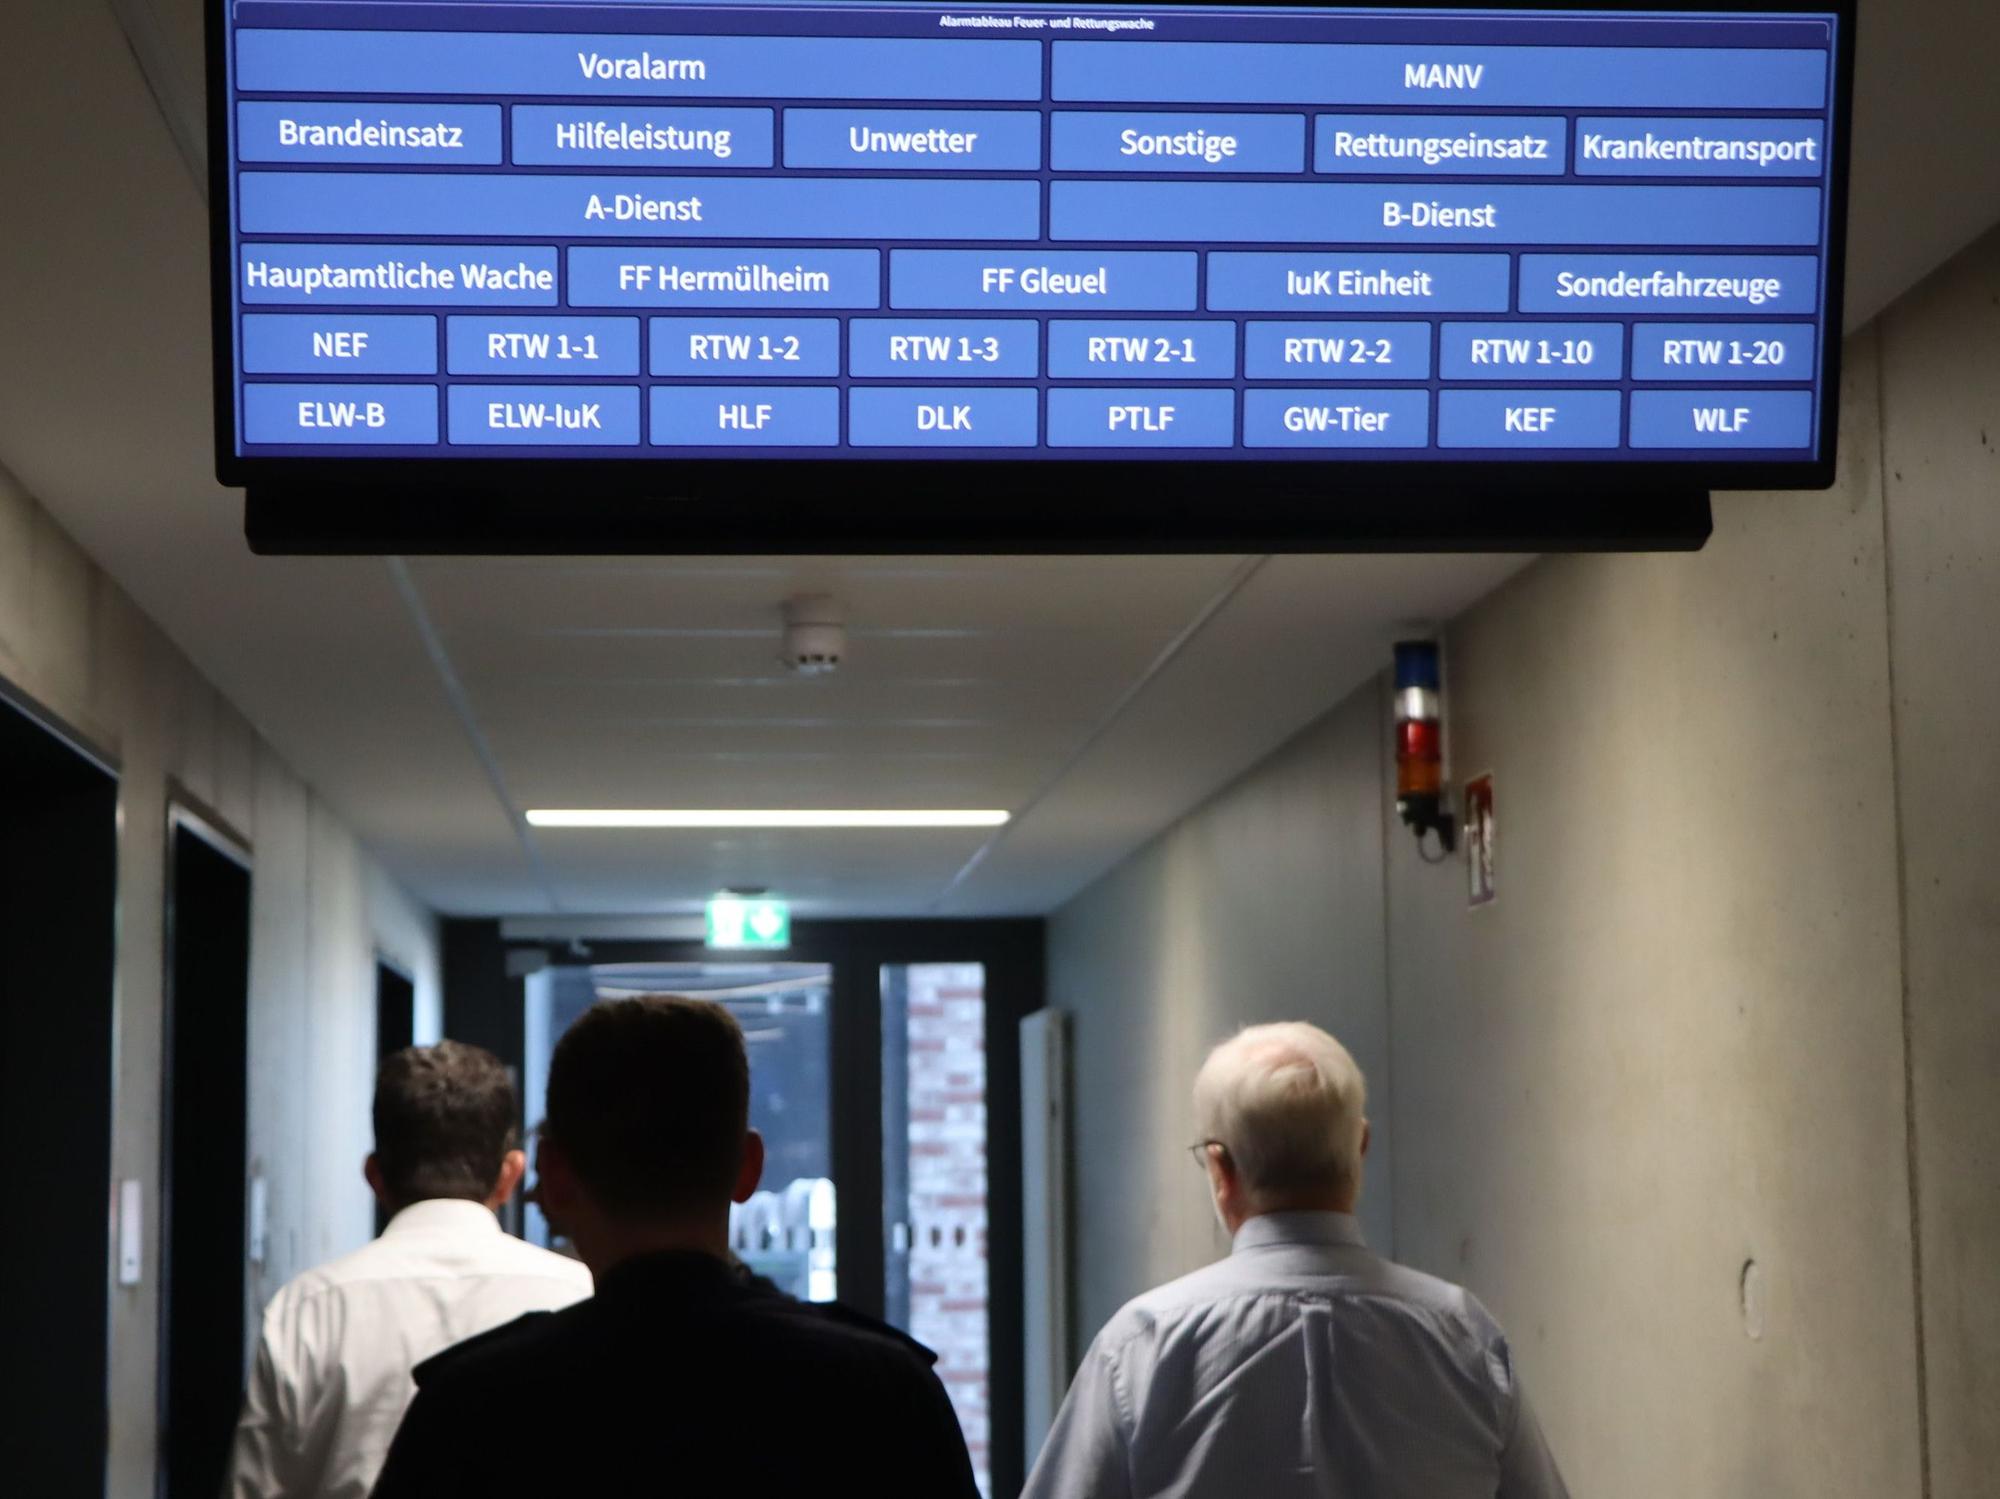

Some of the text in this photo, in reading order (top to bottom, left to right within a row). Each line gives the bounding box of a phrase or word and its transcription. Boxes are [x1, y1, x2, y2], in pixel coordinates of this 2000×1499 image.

[939, 15, 1155, 32] Alarmtableau Feuer- und Rettungswache
[577, 51, 706, 80] Voralarm
[1404, 63, 1484, 89] MANV
[279, 118, 464, 148] Brandeinsatz
[556, 121, 732, 159] Hilfeleistung
[849, 126, 978, 154] Unwetter
[1120, 128, 1238, 164] Sonstige
[1334, 131, 1548, 166] Rettungseinsatz
[1583, 132, 1816, 167] Krankentransport
[584, 193, 703, 222] A-Dienst
[1383, 201, 1496, 228] B-Dienst
[247, 261, 554, 295] Hauptamtliche Wache
[619, 264, 830, 293] FF Hermülheim
[982, 266, 1107, 295] FF Gleuel
[1287, 269, 1433, 297] IuK Einheit
[1556, 270, 1781, 305] Sonderfahrzeuge
[313, 331, 369, 358] NEF
[488, 333, 599, 360] RTW 1-1
[689, 334, 801, 361] RTW 1-2
[890, 335, 1000, 362] RTW 1-3
[1088, 336, 1197, 363] RTW 2-1
[1284, 337, 1392, 364] RTW 2-2
[1471, 339, 1594, 365] RTW 1-10
[1663, 339, 1785, 365] RTW 1-20
[298, 401, 386, 428] ELW-B
[488, 402, 602, 429] ELW-IuK
[719, 404, 773, 430] HLF
[917, 405, 972, 431] DLK
[1108, 405, 1176, 432] PTLF
[1283, 405, 1390, 433] GW-Tier
[1504, 407, 1556, 432] KEF
[1692, 407, 1750, 433] WLF
